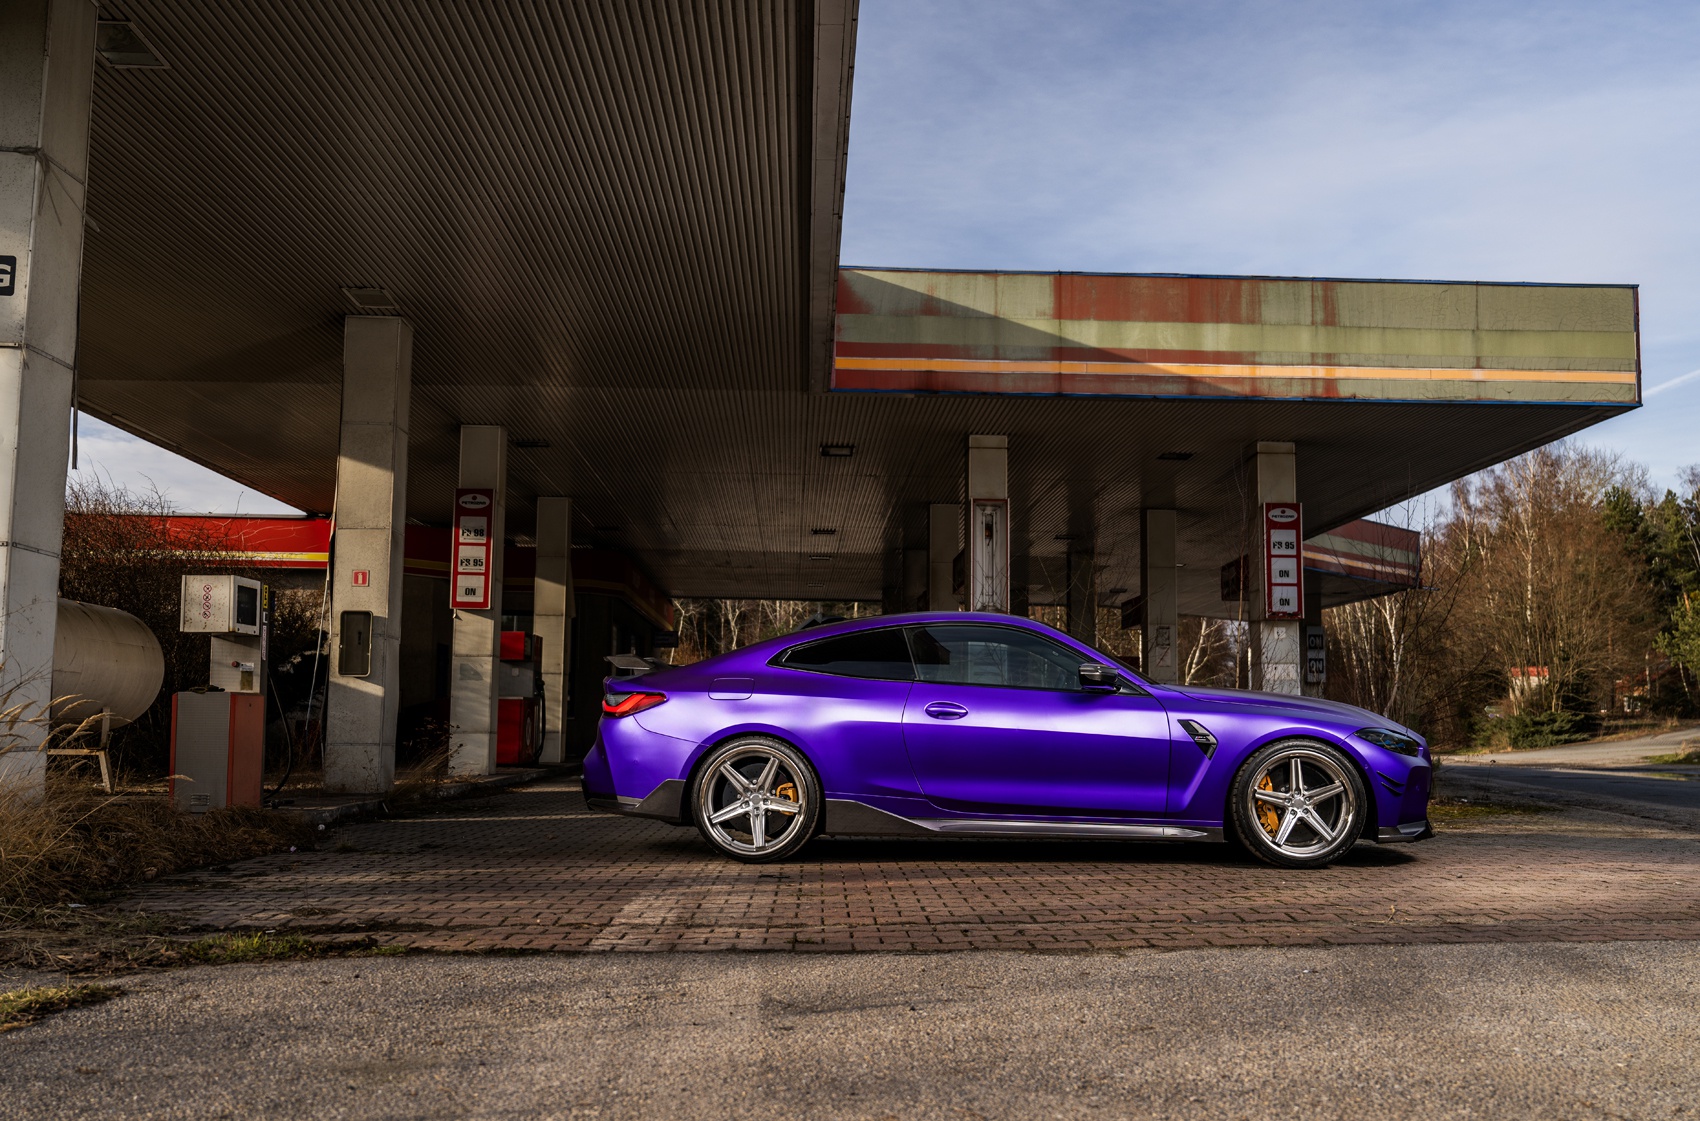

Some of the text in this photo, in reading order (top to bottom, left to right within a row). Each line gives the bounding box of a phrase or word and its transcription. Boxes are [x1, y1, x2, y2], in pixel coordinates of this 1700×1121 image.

[473, 528, 485, 537] 98
[1284, 541, 1295, 550] 95
[473, 558, 484, 567] 95
[1278, 570, 1290, 578] ON
[464, 587, 477, 596] ON
[1279, 598, 1290, 606] ON
[1309, 636, 1323, 648] ON
[1309, 660, 1323, 672] ON
